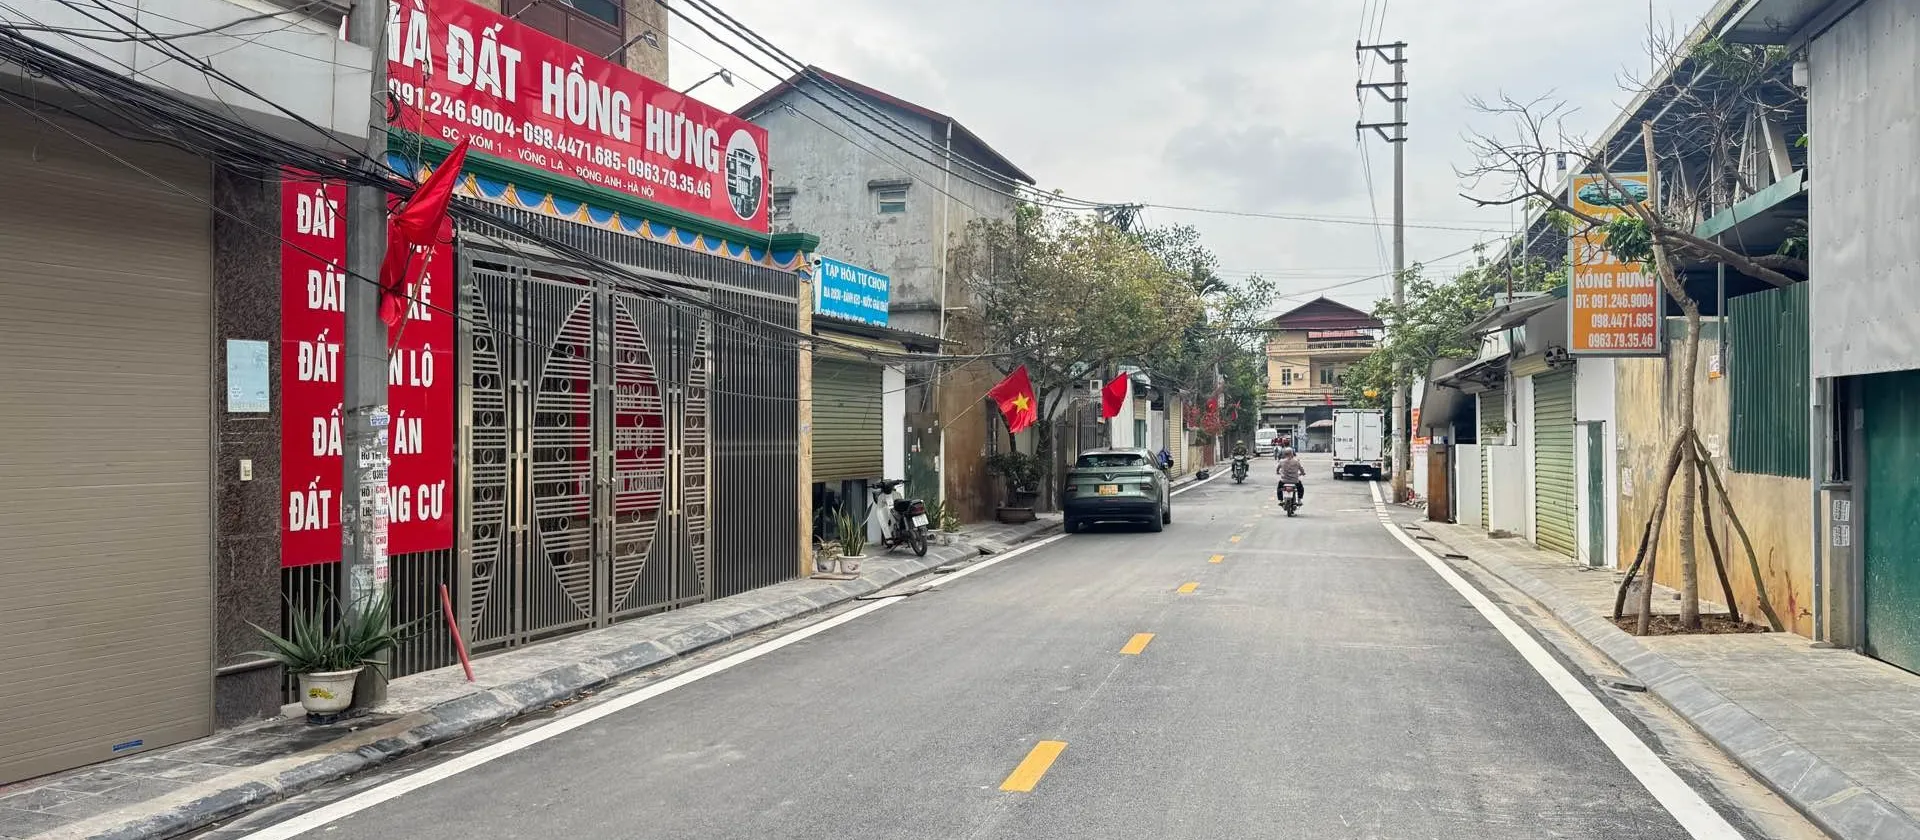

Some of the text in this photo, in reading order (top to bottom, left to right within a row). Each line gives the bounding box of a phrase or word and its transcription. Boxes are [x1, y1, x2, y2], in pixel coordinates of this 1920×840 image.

[446, 23, 521, 103] ĐẤT
[542, 55, 631, 143] HỒNG
[646, 103, 720, 174] HƯNG
[468, 133, 493, 151] XÓM
[497, 142, 502, 153] 1
[551, 158, 564, 171] LA
[576, 166, 601, 182] ĐÔNG
[604, 176, 621, 188] ANH
[627, 181, 638, 194] HÀ
[297, 184, 338, 238] ĐẤT
[825, 263, 839, 279] TẠP
[868, 276, 887, 292] CHỌN
[1592, 294, 1653, 309] 091.246.9004
[1589, 333, 1653, 348] 0963.79.35.46
[1591, 313, 1653, 328] 098.4471.685
[298, 328, 339, 382] ĐẤT
[410, 343, 434, 388] LÔ
[312, 403, 422, 456] ĐẤ ÁN
[289, 476, 331, 532] ĐẤT
[418, 480, 445, 521] CƯ
